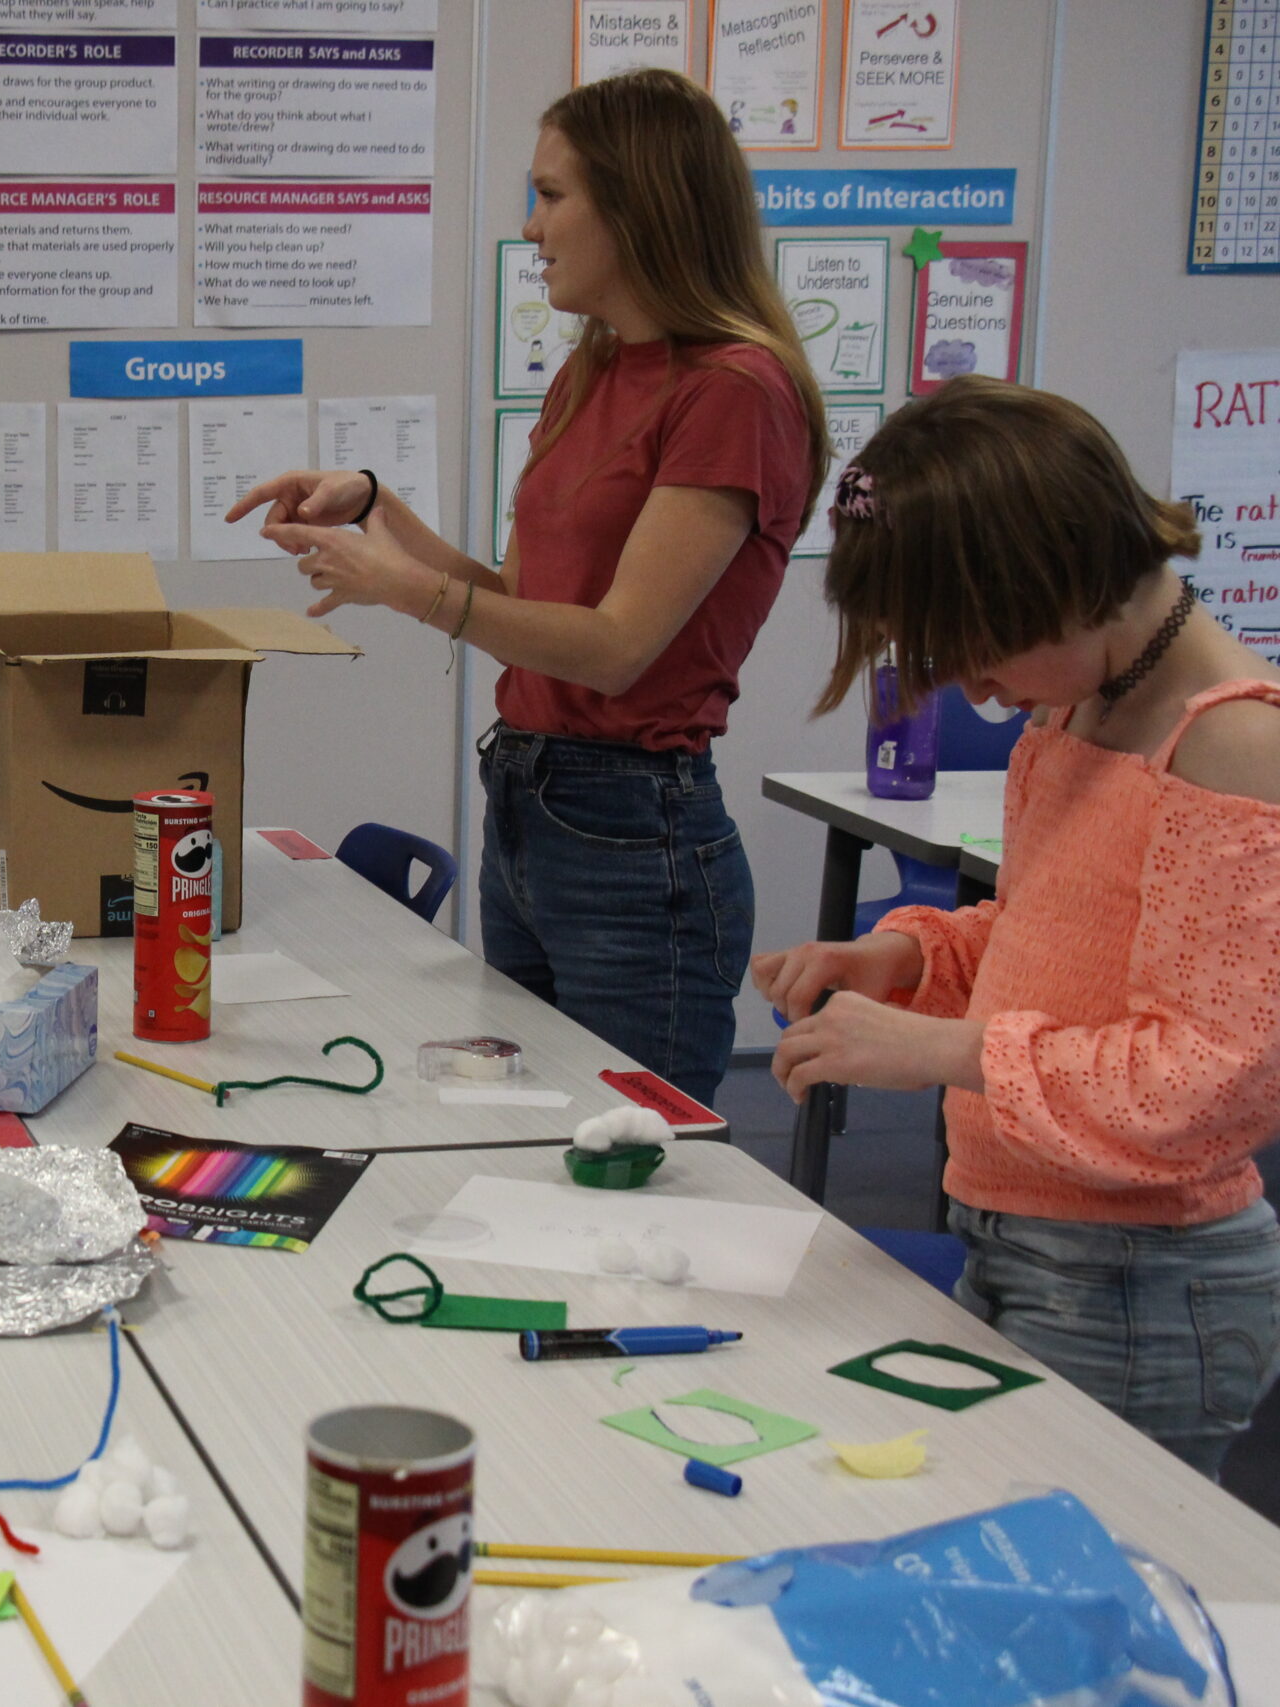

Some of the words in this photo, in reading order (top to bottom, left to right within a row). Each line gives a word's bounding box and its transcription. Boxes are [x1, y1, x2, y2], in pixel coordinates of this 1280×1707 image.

[589, 15, 661, 31] Mistakes
[667, 16, 679, 31] &
[721, 4, 817, 38] Metacognition
[1217, 18, 1226, 30] 3
[589, 33, 629, 48] Stuck
[634, 33, 679, 48] Points
[738, 30, 806, 58] Reflection
[83, 45, 122, 58] ROLE
[233, 46, 304, 60] RECORDER
[308, 47, 339, 60] SAYS
[341, 48, 366, 60] and
[368, 48, 401, 61] ASKS
[1215, 44, 1224, 56] 4
[860, 51, 929, 66] Persevere
[932, 51, 943, 66] &
[855, 72, 896, 86] SEEK
[899, 71, 945, 86] MORE
[1214, 69, 1222, 82] 5
[1, 76, 34, 87] draws
[36, 76, 51, 87] for
[53, 76, 72, 87] the
[73, 80, 107, 90] group
[108, 77, 155, 91] product.
[206, 77, 235, 88] What
[236, 78, 276, 92] writing
[291, 78, 335, 92] drawing
[371, 79, 398, 90] need
[4, 96, 25, 107] and
[27, 100, 90, 111] encourages
[92, 100, 142, 111] everyone
[206, 89, 221, 100] for
[223, 89, 242, 100] the
[243, 89, 282, 104] group?
[1211, 95, 1221, 107] 6
[24, 110, 78, 121] individual
[79, 110, 109, 121] work.
[206, 109, 234, 120] What
[253, 113, 274, 123] you
[275, 110, 304, 121] think
[305, 110, 337, 121] about
[339, 110, 365, 121] what
[207, 121, 274, 135] wrote/drew?
[1209, 120, 1218, 132] 7
[1207, 146, 1216, 158] 8
[205, 153, 272, 167] individually?
[1205, 171, 1214, 183] 9
[31, 193, 117, 206] MANAGER'S
[123, 193, 160, 206] ROLE
[199, 192, 267, 205] RESOURCE
[269, 192, 334, 205] MANAGER
[336, 192, 368, 205] SAYS
[370, 193, 395, 205] and
[397, 192, 430, 205] ASKS
[755, 184, 816, 210] abits
[823, 184, 852, 209] of
[857, 184, 1005, 209] Interaction
[1200, 196, 1216, 207] 10
[38, 224, 59, 235] and
[61, 224, 99, 235] returns
[101, 224, 132, 235] them.
[204, 223, 233, 234] What
[234, 223, 284, 234] materials
[319, 223, 352, 234] need?
[1198, 221, 1213, 232] 11
[6, 240, 29, 250] that
[30, 240, 80, 250] materials
[101, 240, 127, 251] used
[129, 240, 174, 254] properly
[204, 241, 225, 252] Will
[226, 244, 247, 255] you
[248, 241, 273, 255] help
[274, 241, 303, 252] clean
[305, 241, 324, 255] up?
[1196, 246, 1212, 257] 12
[807, 256, 845, 272] Listen
[848, 257, 861, 272] to
[6, 272, 56, 282] everyone
[58, 269, 93, 279] cleans
[94, 272, 111, 283] up.
[797, 274, 869, 290] Understand
[60, 284, 76, 295] for
[77, 284, 96, 295] the
[98, 288, 131, 298] group
[132, 284, 153, 295] and
[204, 277, 233, 288] What
[268, 277, 296, 288] need
[311, 277, 334, 288] look
[336, 277, 355, 291] up?
[928, 290, 993, 307] Genuine
[21, 314, 49, 324] time.
[927, 314, 1006, 330] Questions
[125, 357, 226, 385] Groups
[1236, 494, 1280, 521] rat
[164, 817, 198, 825] BURSTING
[172, 876, 212, 902] PRINGLE
